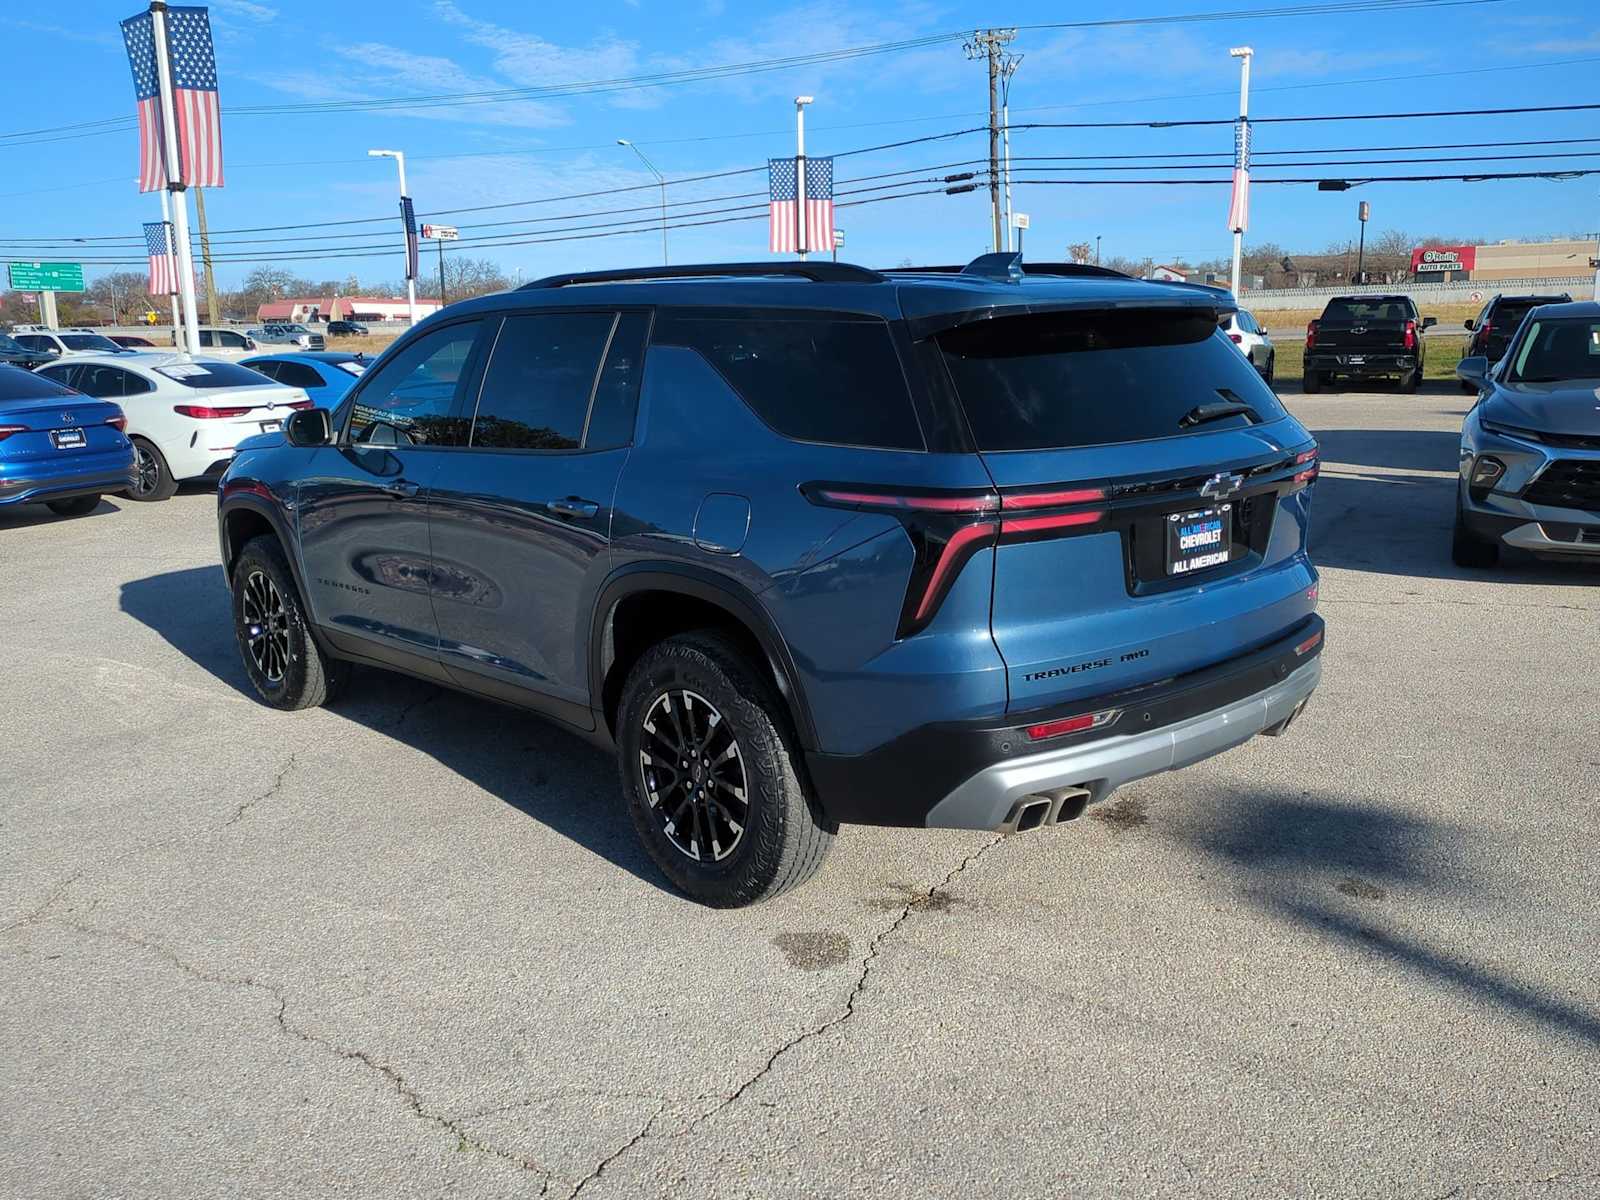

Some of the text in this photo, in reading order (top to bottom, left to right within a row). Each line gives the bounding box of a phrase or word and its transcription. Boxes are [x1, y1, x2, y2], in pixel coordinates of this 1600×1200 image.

[1424, 250, 1459, 262] O'Reilly
[1439, 263, 1462, 271] PARTS
[1181, 521, 1222, 537] ALL AMERICAN
[1180, 529, 1222, 549] CHEVROLET
[1173, 551, 1229, 574] ALL AMERICAN
[1023, 649, 1150, 681] TRAVERSE AWD
